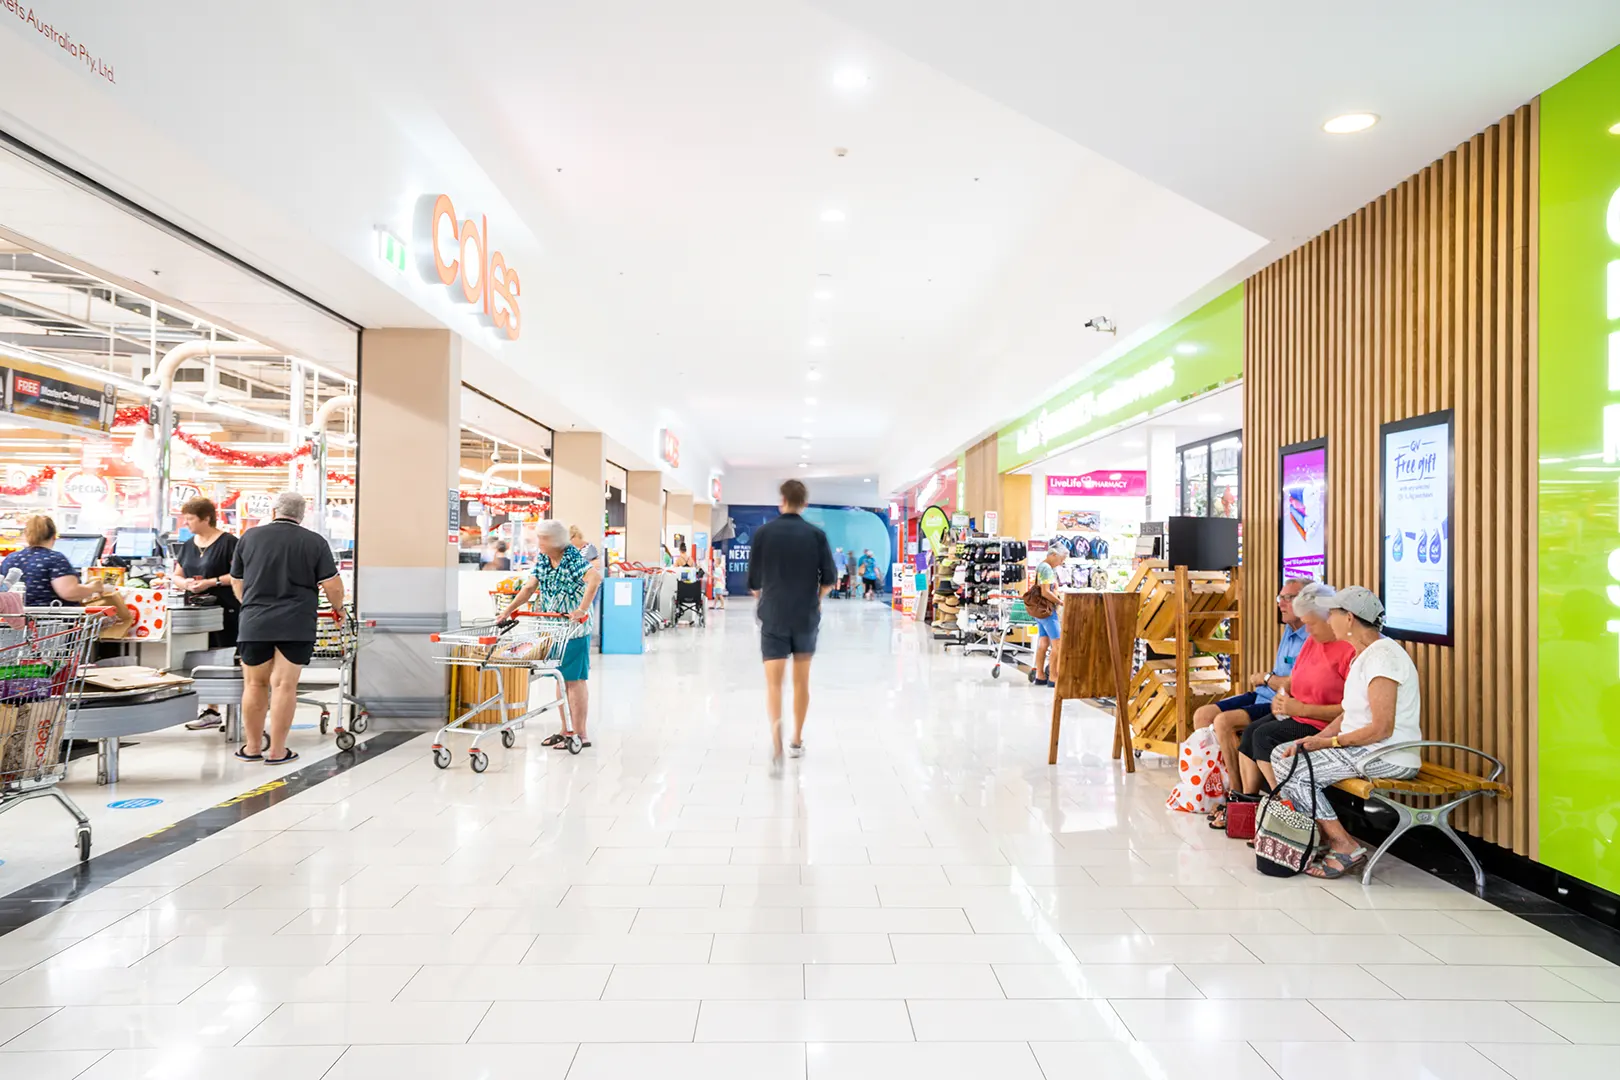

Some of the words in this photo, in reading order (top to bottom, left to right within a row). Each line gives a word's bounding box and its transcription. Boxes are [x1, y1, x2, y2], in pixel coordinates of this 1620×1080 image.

[26, 8, 77, 57] Australia
[79, 43, 97, 73] Pty.
[98, 57, 116, 84] Ltd.
[431, 193, 521, 341] coles
[17, 379, 39, 394] FREE
[1394, 453, 1416, 480] Free
[1418, 453, 1437, 481] gift
[64, 484, 108, 494] SPECIAL
[1050, 477, 1082, 488] LiveLife
[1093, 480, 1127, 489] PHARMACY
[728, 549, 751, 560] NEXT
[1205, 782, 1223, 793] BAG
